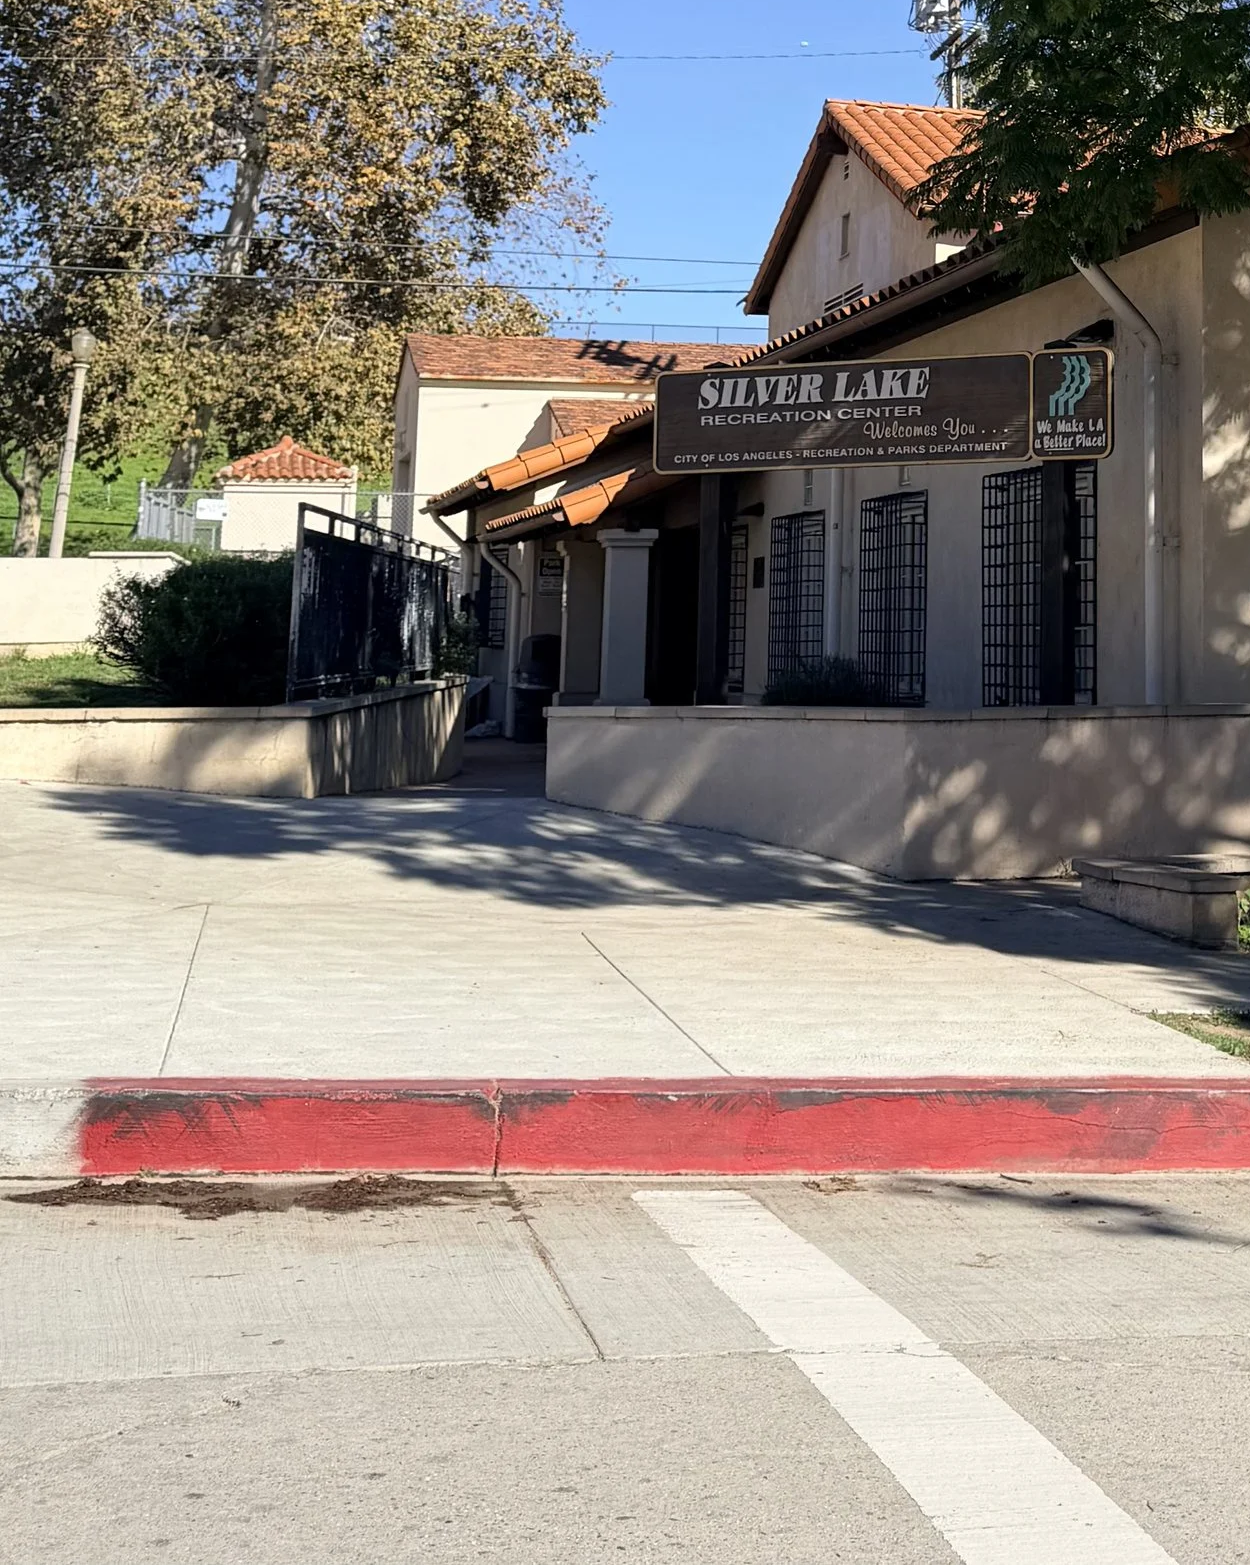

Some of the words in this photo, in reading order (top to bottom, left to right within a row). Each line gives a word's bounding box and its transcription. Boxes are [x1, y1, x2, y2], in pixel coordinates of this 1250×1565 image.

[697, 373, 824, 410] SILVER
[831, 367, 930, 402] LAKE
[700, 409, 832, 427] RECREATION
[837, 405, 923, 420] CENTER
[1036, 419, 1053, 434] We
[1056, 418, 1085, 433] Make
[1088, 417, 1104, 432] LA
[863, 420, 938, 440] Welcomes
[942, 417, 976, 441] You
[1034, 439, 1042, 449] a
[1043, 434, 1074, 449] Better
[1075, 433, 1106, 448] Place!
[674, 454, 698, 464] CITY
[701, 454, 716, 463] OF
[718, 452, 740, 462] LOS
[742, 450, 793, 461] ANGELES
[803, 447, 874, 459] RECREATION
[876, 447, 884, 455] &
[888, 445, 926, 455] PARKS
[929, 441, 1008, 453] DEPARTMENT
